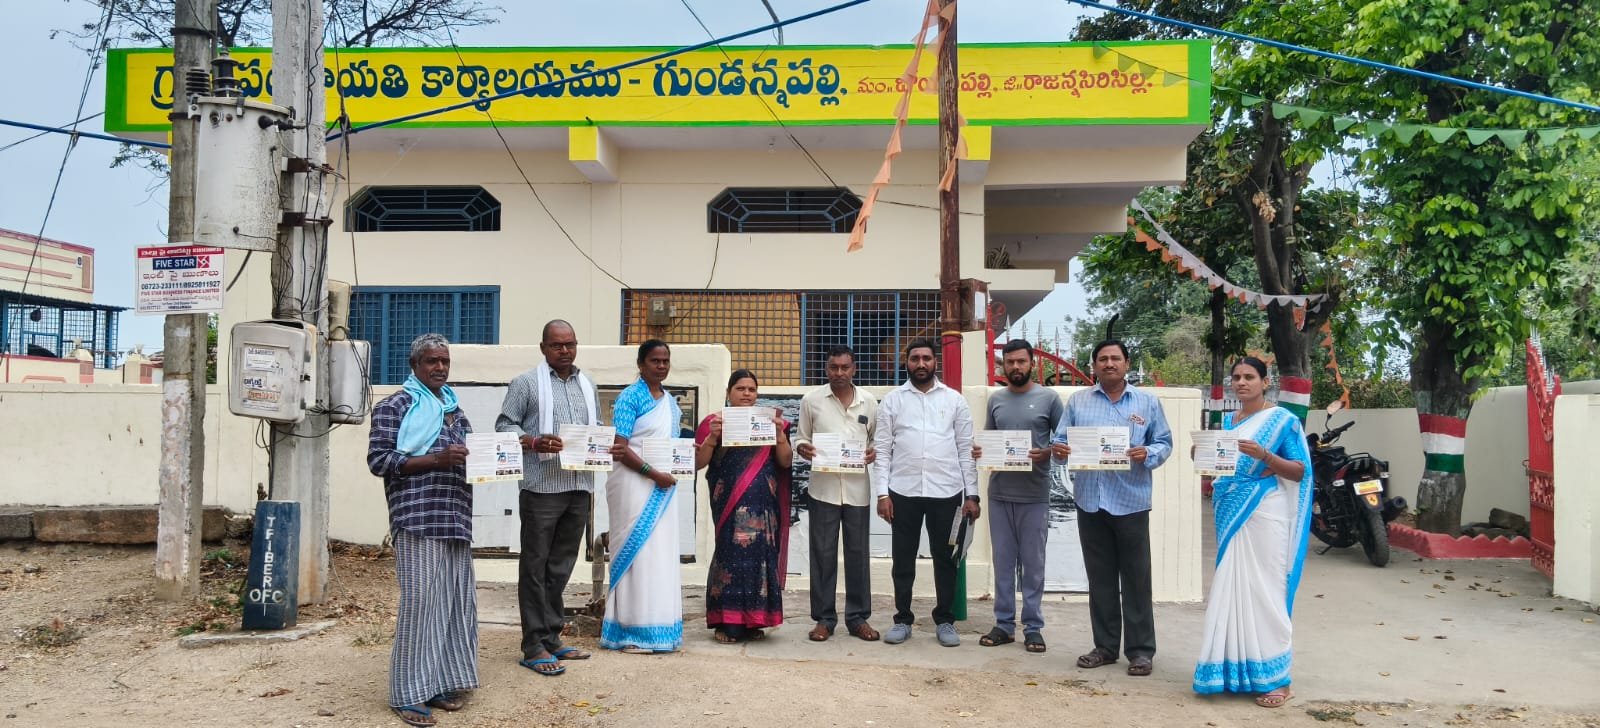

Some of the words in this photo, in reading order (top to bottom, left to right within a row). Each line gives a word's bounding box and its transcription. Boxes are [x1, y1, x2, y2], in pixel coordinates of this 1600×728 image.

[155, 260, 173, 268] FIVE
[174, 259, 195, 267] STAR
[249, 588, 284, 604] OFC
